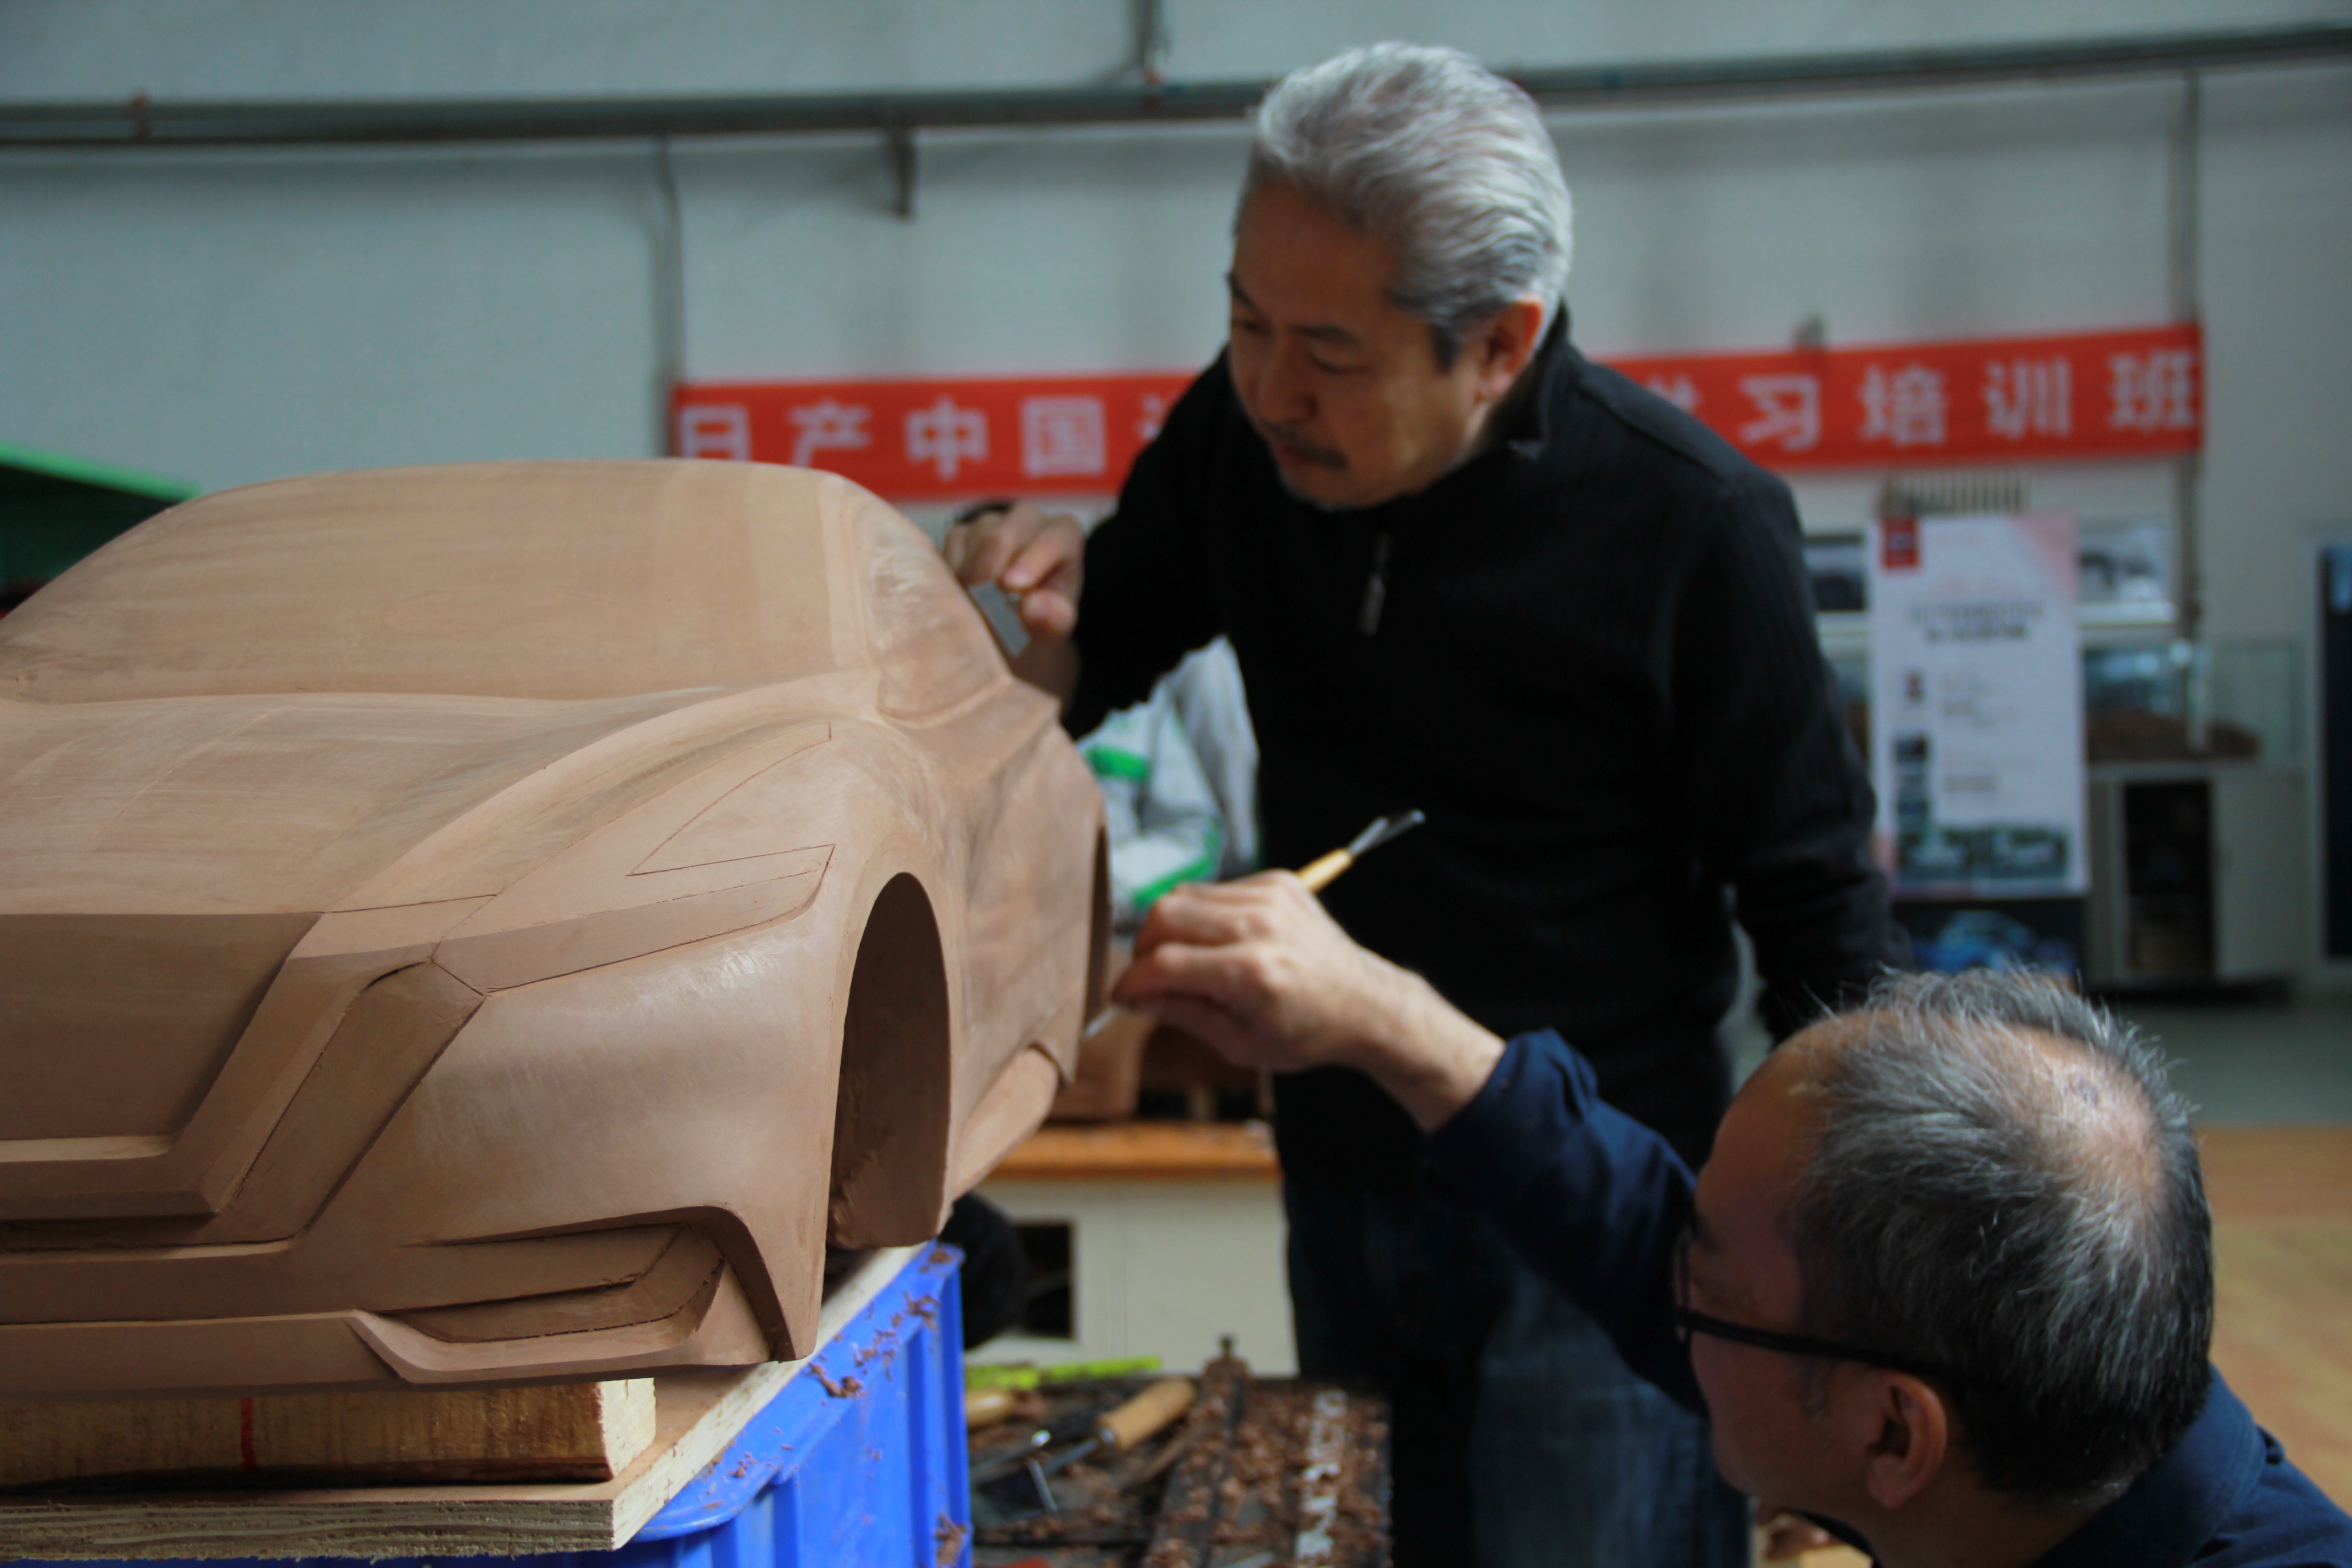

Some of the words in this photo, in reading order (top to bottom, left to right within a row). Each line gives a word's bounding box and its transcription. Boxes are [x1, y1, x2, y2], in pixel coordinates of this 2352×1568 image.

[682, 396, 1177, 480] 日产中国
[1643, 349, 2195, 449] 习培训班
